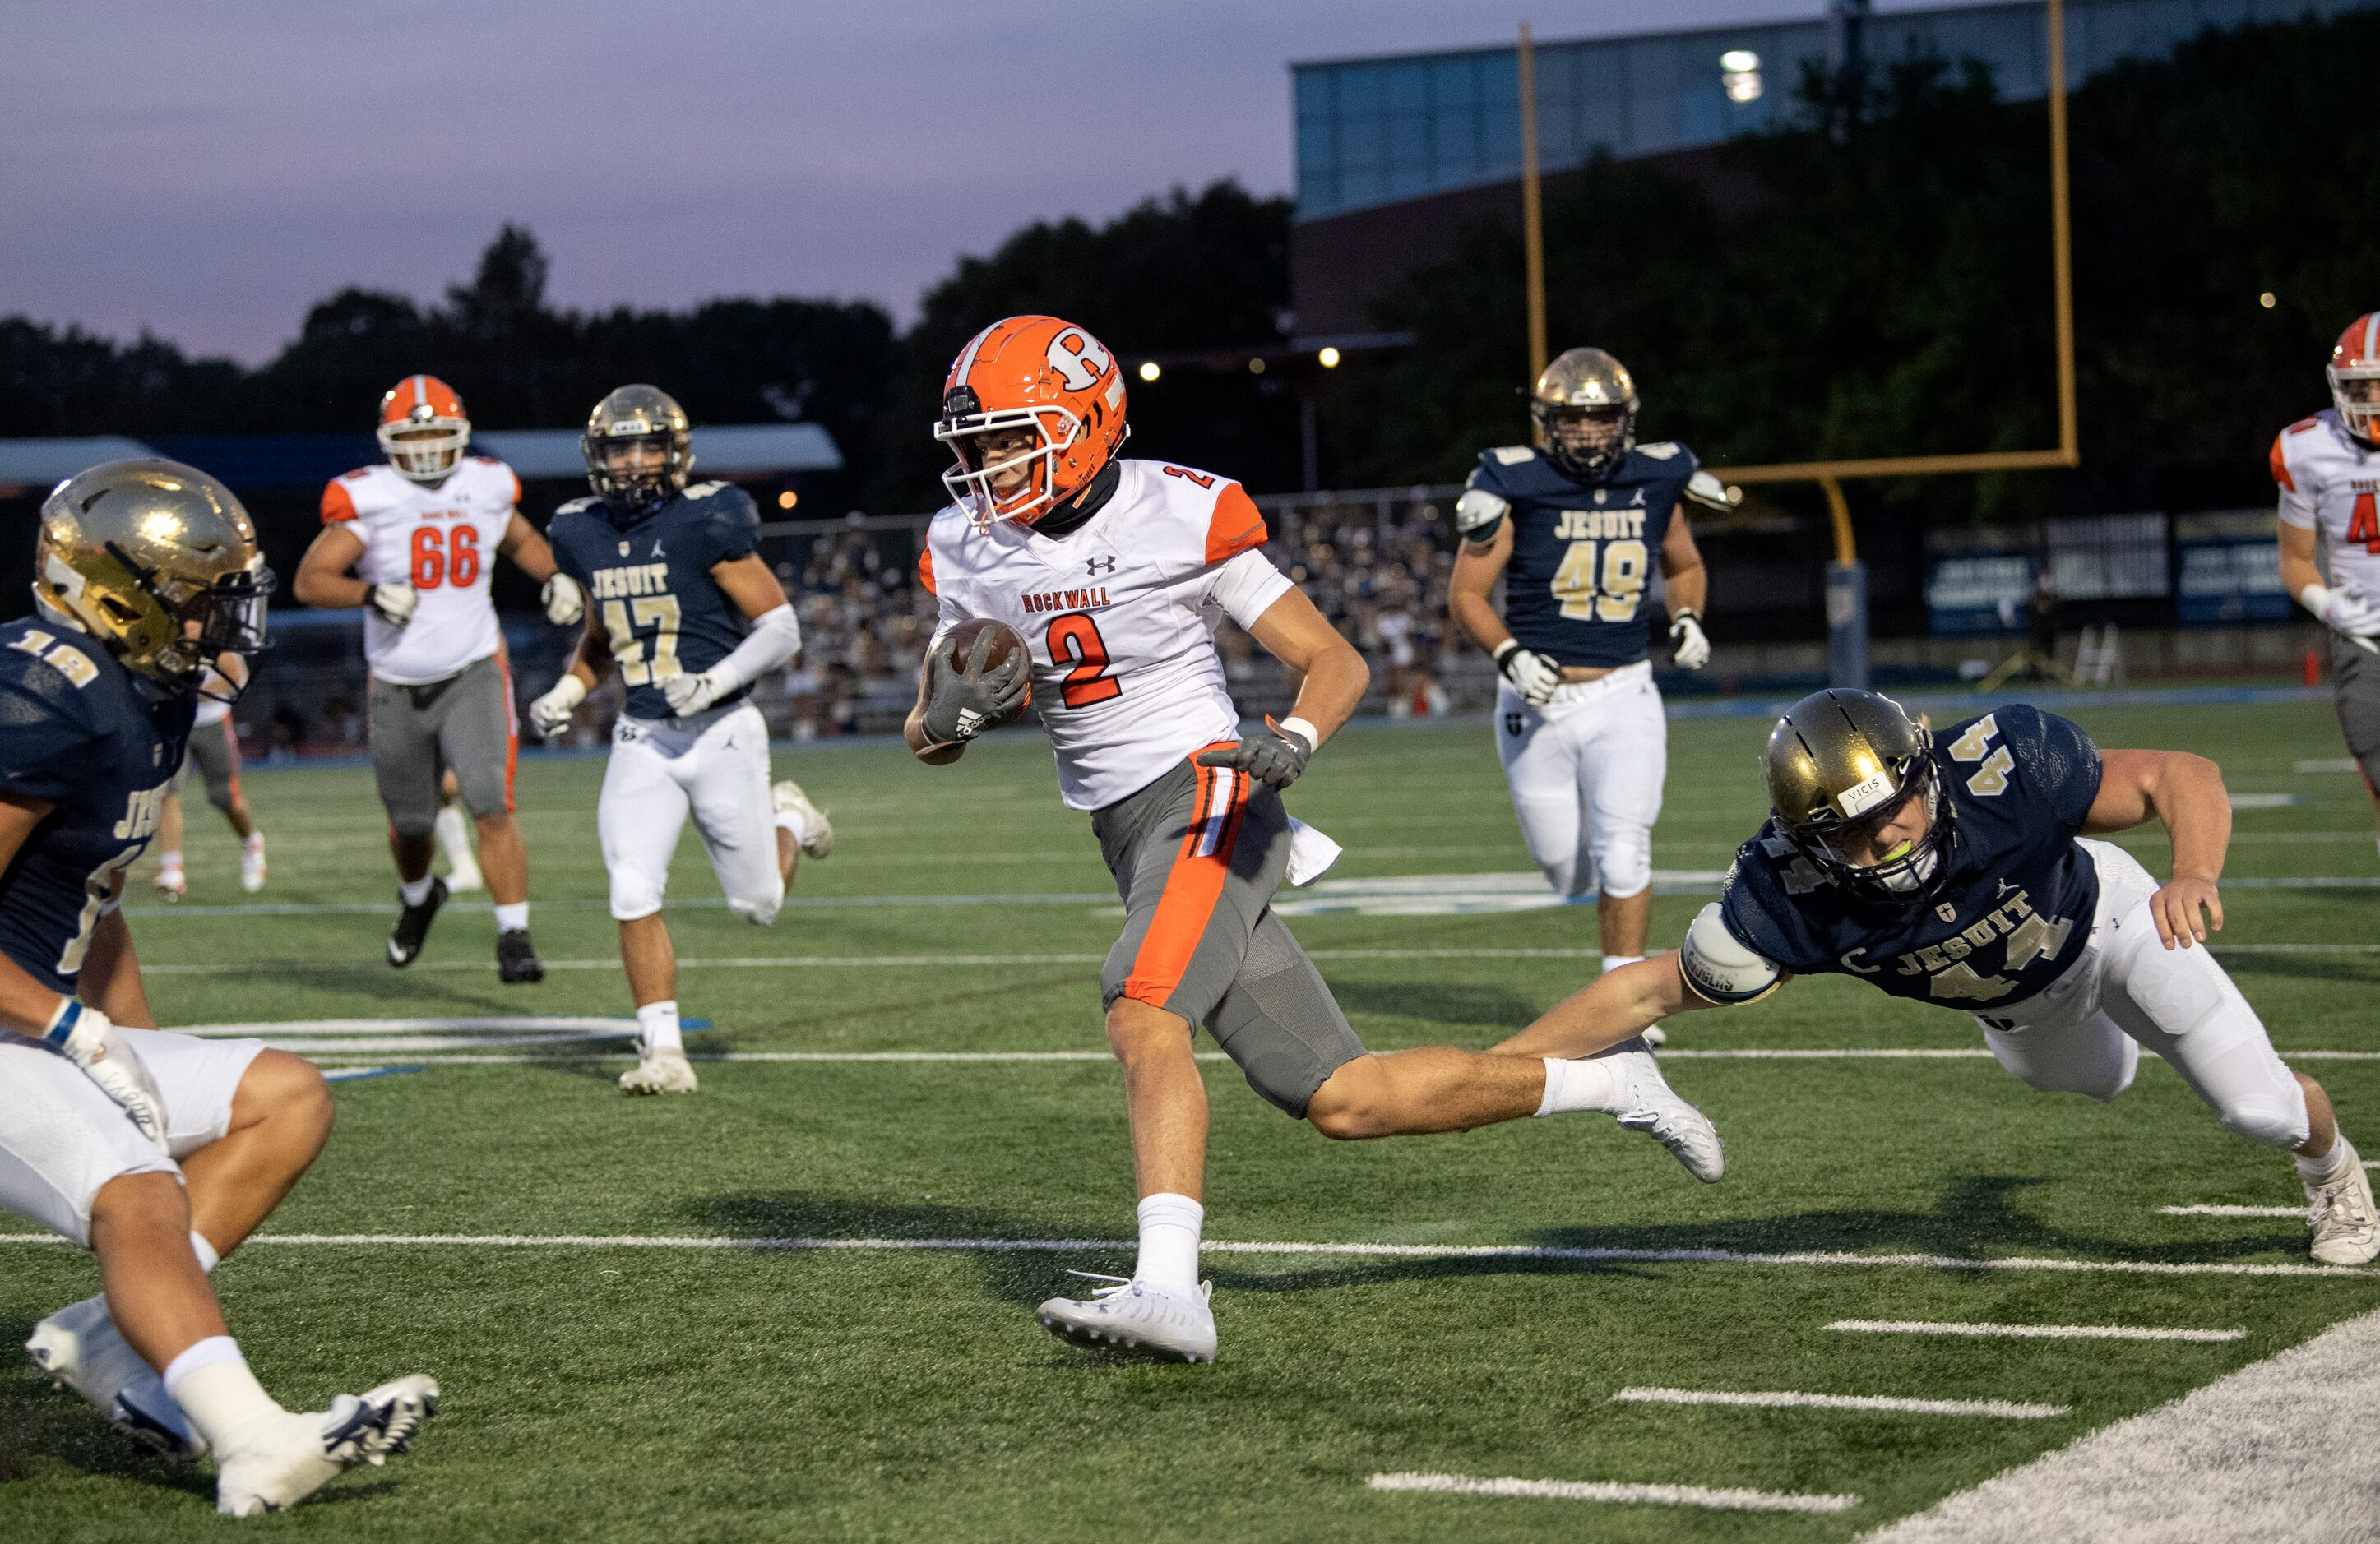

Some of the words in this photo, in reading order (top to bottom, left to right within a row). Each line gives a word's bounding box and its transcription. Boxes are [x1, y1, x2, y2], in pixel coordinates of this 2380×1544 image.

[1163, 465, 1215, 490] 2
[1554, 509, 1646, 539] JESUIT
[411, 524, 480, 590] 66
[592, 563, 668, 599] JESUIT
[1550, 539, 1648, 622] 49
[1021, 587, 1110, 613] ROCKWALL
[7, 629, 100, 689] 18
[603, 594, 682, 686] 47
[1045, 611, 1123, 710] 2
[1947, 713, 2016, 796] 44
[1848, 779, 1880, 801] VICIS
[1841, 947, 1882, 973] C
[1897, 890, 2033, 976] JESUIT
[1929, 912, 2074, 1001] 44
